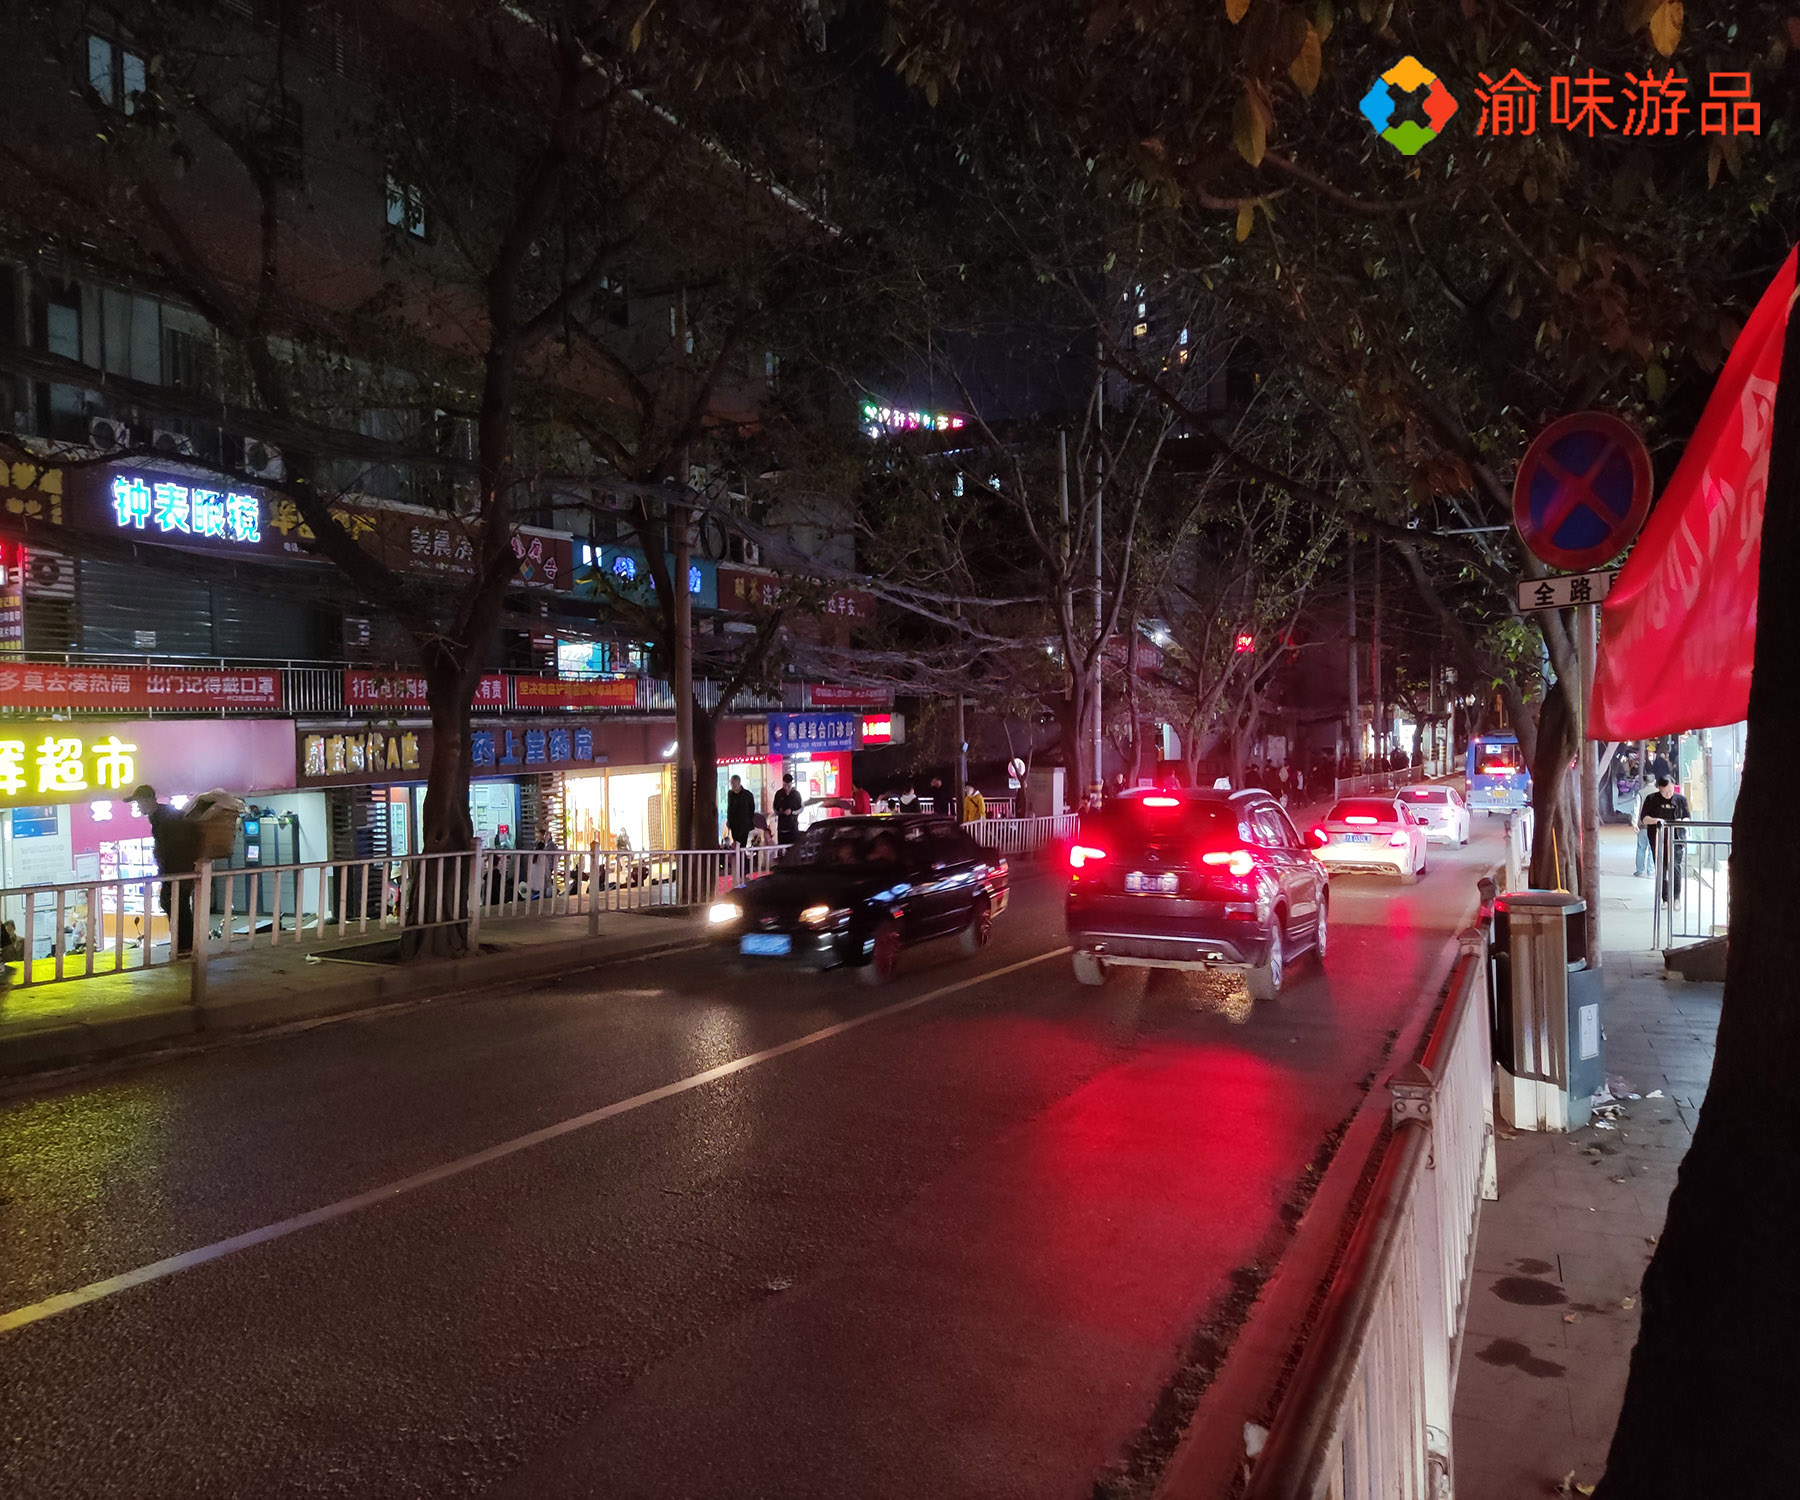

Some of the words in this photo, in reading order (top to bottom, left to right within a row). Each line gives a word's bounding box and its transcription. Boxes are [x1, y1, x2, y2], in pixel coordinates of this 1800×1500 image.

[112, 474, 261, 543] 钟表眼镜
[1534, 571, 1620, 607] 全路
[147, 676, 274, 695] 出门记得戴口罩
